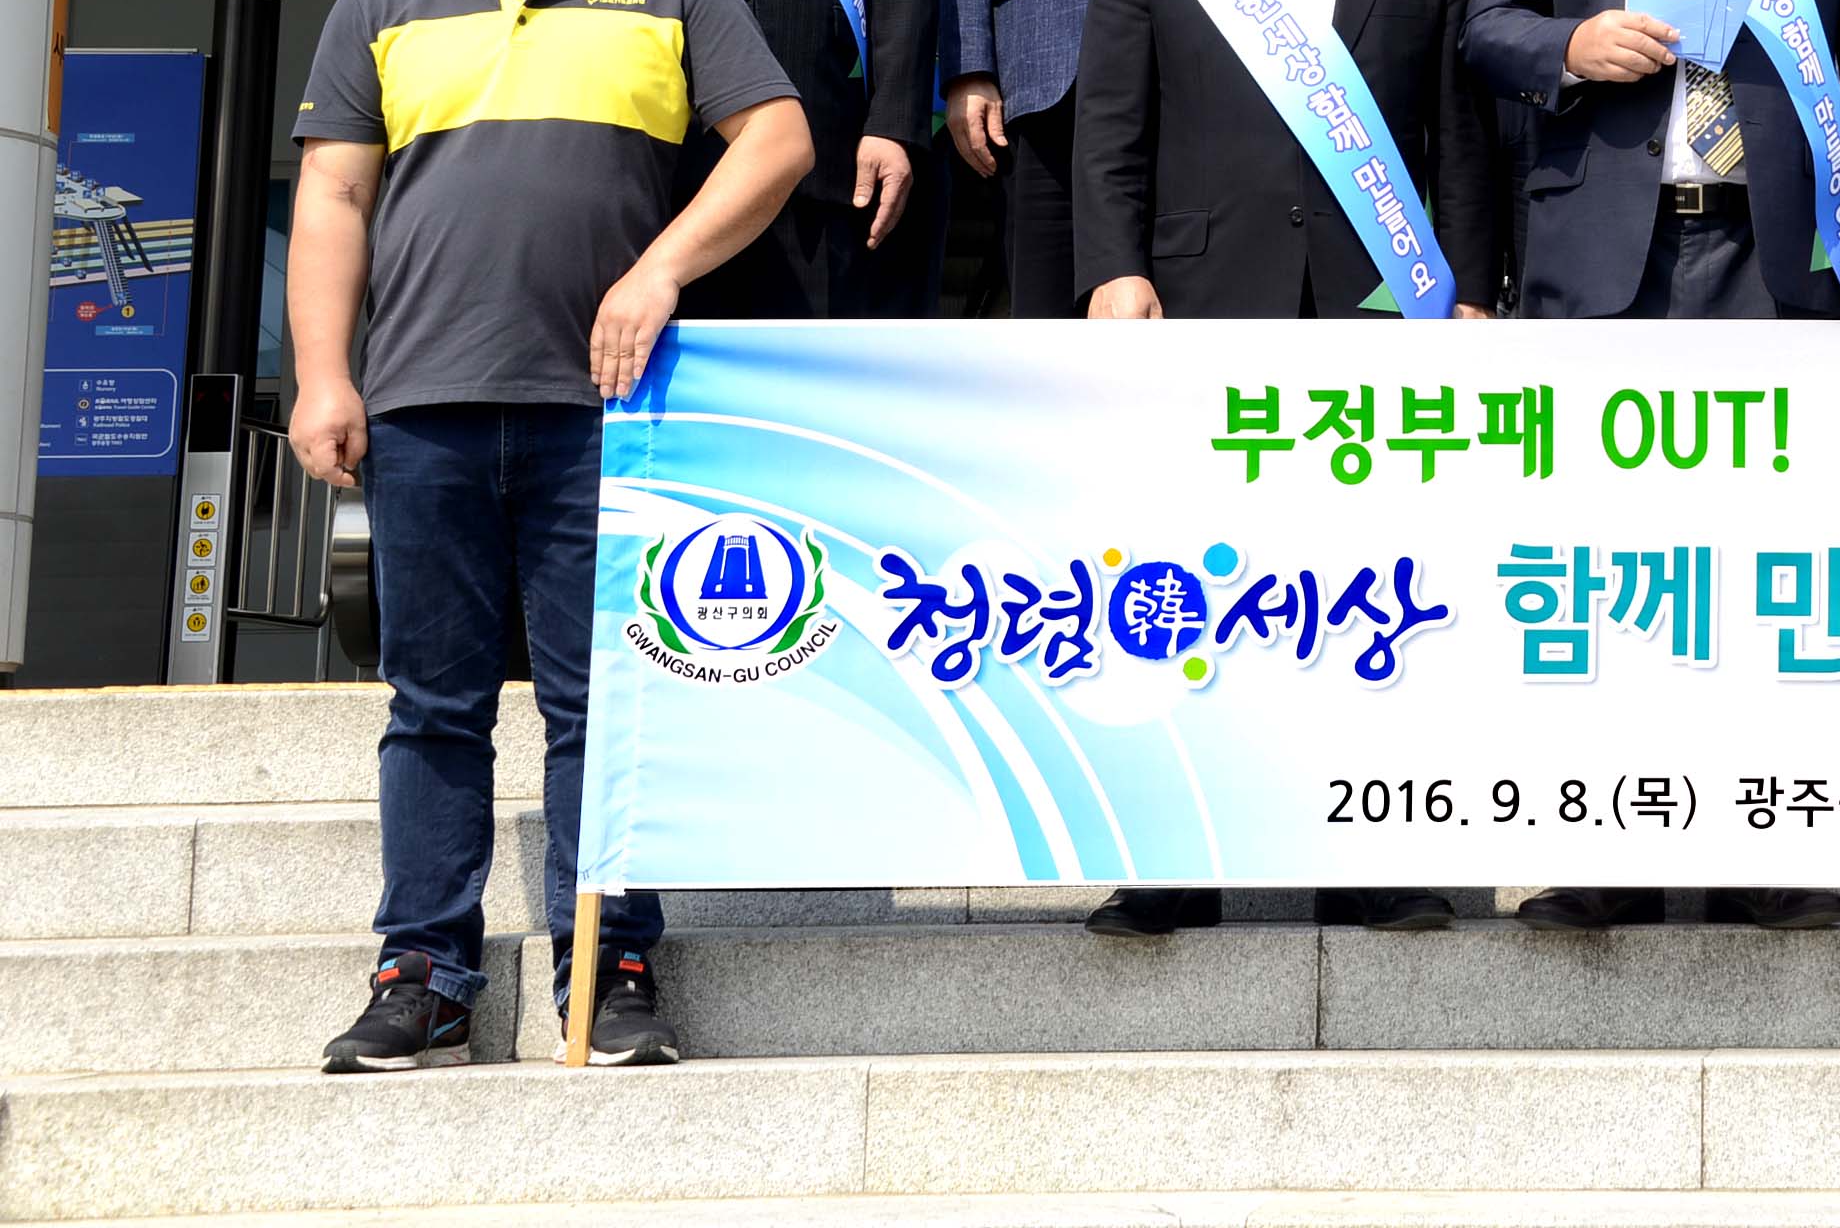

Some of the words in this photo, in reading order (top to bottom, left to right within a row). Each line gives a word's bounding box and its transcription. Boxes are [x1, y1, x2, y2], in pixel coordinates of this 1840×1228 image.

[1781, 16, 1826, 86] 함께
[1306, 81, 1372, 152] 함께
[1211, 384, 1554, 485] 부정부패
[1601, 386, 1789, 474] OUT!
[697, 606, 768, 620] 광산구의회
[1497, 543, 1711, 675] 함께
[626, 622, 760, 683] GWANGSAN-GU
[764, 621, 838, 677] COUNCIL
[1326, 778, 1470, 827] 2016.
